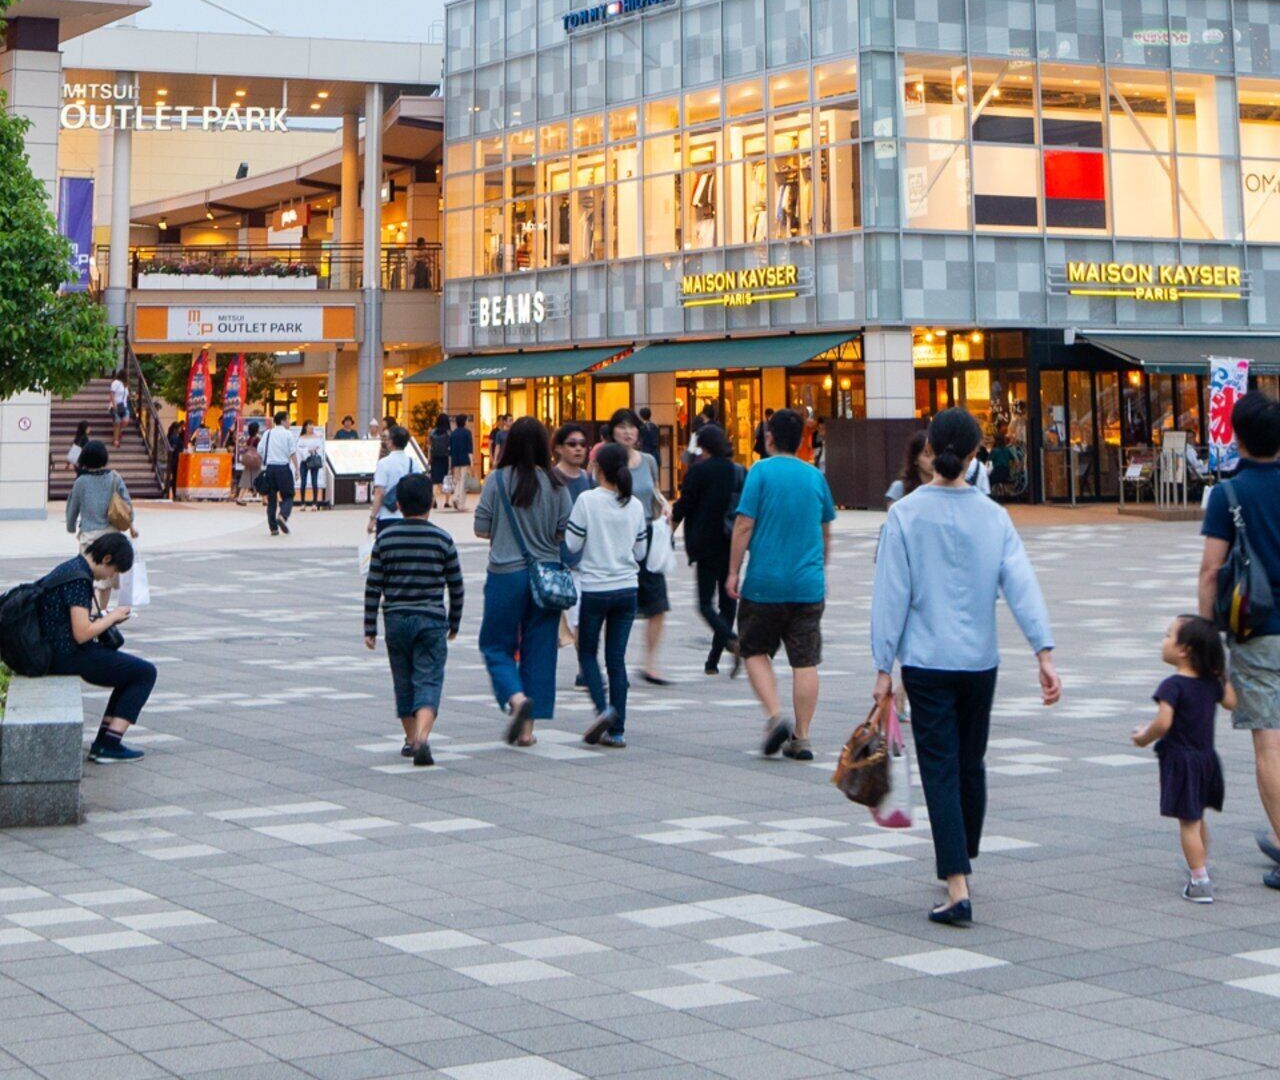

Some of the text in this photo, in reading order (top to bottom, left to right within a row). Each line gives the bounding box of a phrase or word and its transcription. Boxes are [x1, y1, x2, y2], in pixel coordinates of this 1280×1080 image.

[562, 3, 607, 30] TOMMY
[63, 83, 135, 100] MITSUI
[60, 103, 288, 132] OUTLET PARK
[682, 265, 797, 294] MAISON KAYSER
[1067, 262, 1241, 286] MAISON KAYSER
[723, 293, 752, 306] PARIS
[1135, 287, 1179, 301] PARIS
[479, 290, 545, 327] BEAMS
[217, 322, 303, 333] OUTLET PARK
